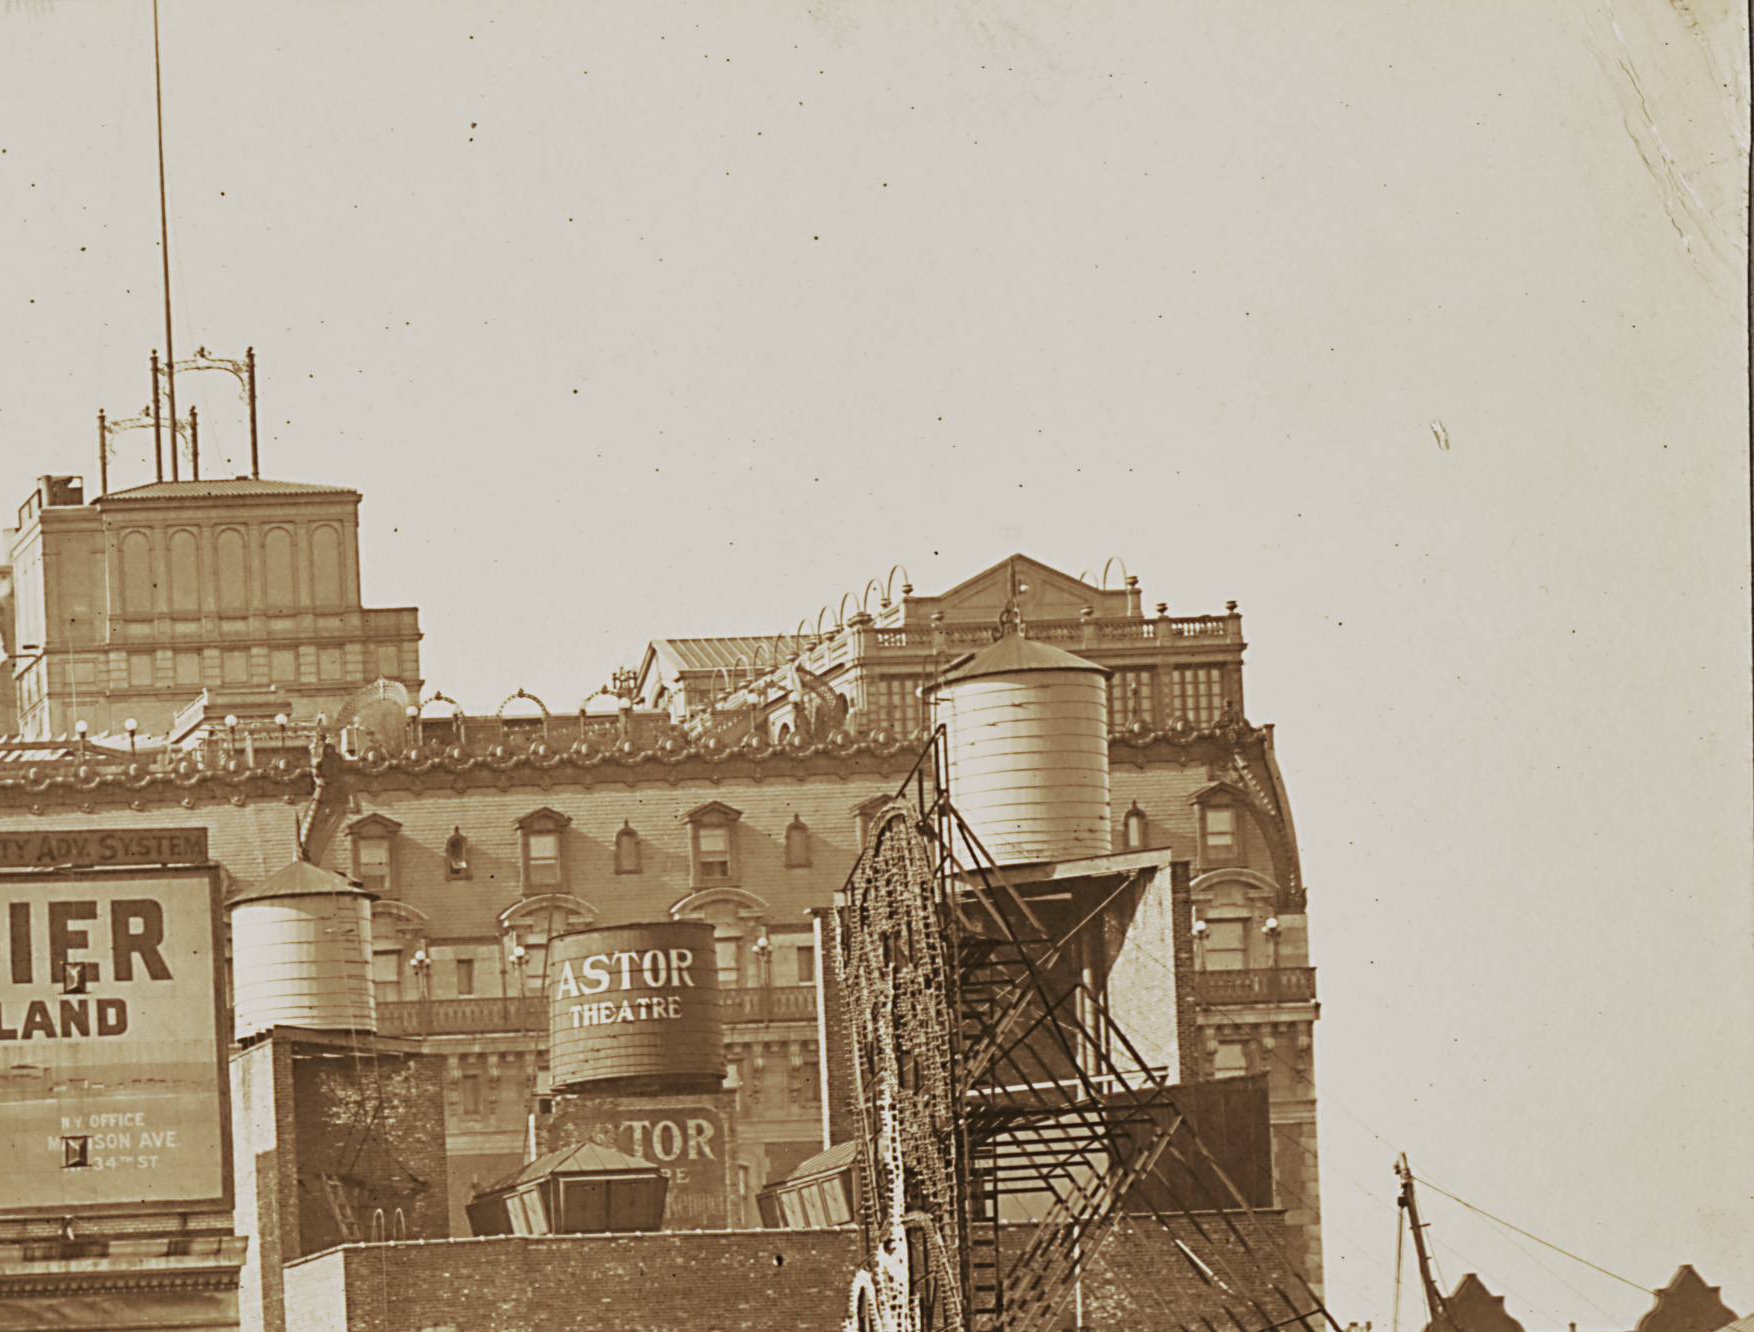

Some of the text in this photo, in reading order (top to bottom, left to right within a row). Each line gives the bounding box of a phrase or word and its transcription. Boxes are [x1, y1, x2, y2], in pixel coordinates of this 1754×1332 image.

[98, 831, 207, 861] SYSTEM
[556, 948, 696, 1001] ASTOR
[570, 997, 683, 1029] THEATRE
[89, 1113, 145, 1128] OFFICE
[48, 1133, 131, 1151] MISON
